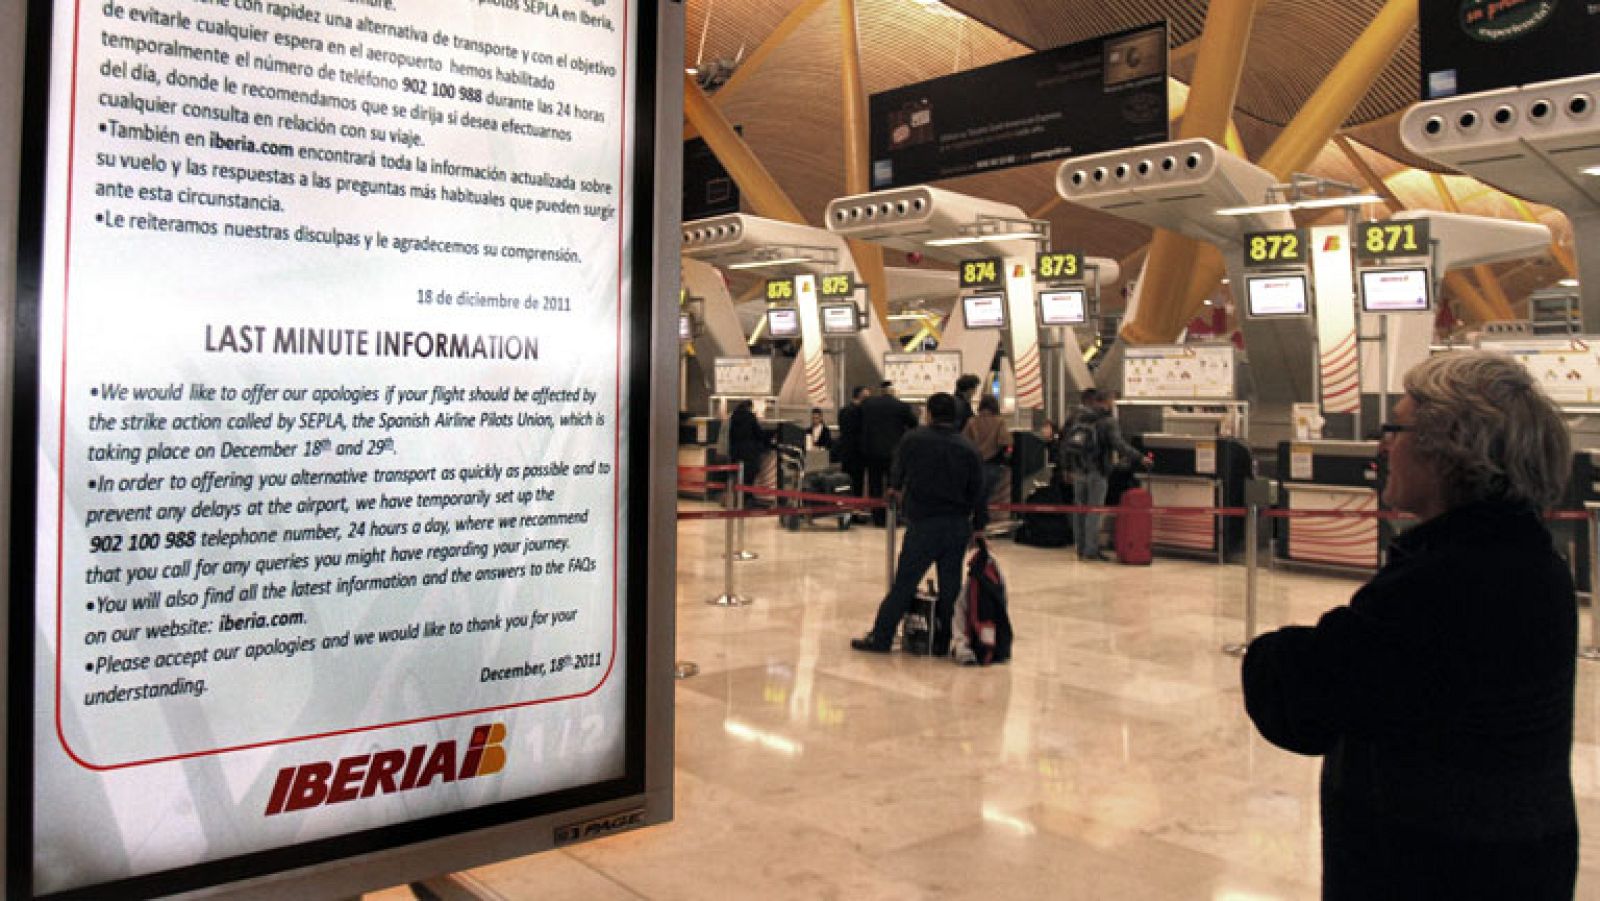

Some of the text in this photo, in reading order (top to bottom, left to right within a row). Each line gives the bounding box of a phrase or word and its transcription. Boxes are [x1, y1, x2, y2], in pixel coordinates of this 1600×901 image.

[101, 30, 229, 65] temporalmente
[234, 50, 250, 67] el
[253, 53, 313, 77] número
[316, 62, 336, 81] de
[338, 68, 398, 90] teléfono
[401, 76, 427, 94] 902
[432, 81, 456, 98] 100
[457, 85, 482, 103] 988
[485, 90, 534, 111] durante
[537, 98, 553, 115] las
[555, 101, 571, 117] 24
[99, 58, 127, 78] del
[165, 68, 219, 92] donde
[224, 75, 237, 94] le
[241, 82, 356, 111] recomendamos
[360, 99, 388, 116] que
[391, 103, 406, 117] se
[409, 103, 444, 126] dirija
[459, 111, 498, 131] desea
[501, 117, 571, 142] efectuarnos
[97, 91, 177, 115] cualquier
[181, 103, 250, 124] consulta
[253, 112, 273, 127] en
[276, 113, 336, 135] relación
[339, 124, 367, 138] con
[370, 128, 386, 142] su
[108, 118, 612, 194] También en iberia.com encontrará toda la información actualizada sobre
[95, 182, 284, 212] ante esta circunstancia.
[105, 209, 124, 227] Le
[128, 211, 217, 236] reiteramos
[224, 222, 290, 240] nuestras
[293, 224, 360, 248] disculpas
[363, 234, 373, 250] y
[376, 230, 388, 248] le
[391, 235, 479, 255] agradecemos
[482, 243, 498, 257] su
[1250, 233, 1299, 261] 872
[1366, 224, 1417, 253] 871
[964, 261, 996, 283] 874
[1040, 254, 1078, 277] 873
[768, 280, 793, 299] 876
[822, 275, 848, 294] 875
[416, 289, 571, 311] 18 de diciembre de 2011
[205, 324, 538, 359] LAST MINUTE INFORMATION
[100, 383, 596, 405] We would like to offer our apologies if your flight should be affected by
[88, 412, 117, 430] the
[120, 412, 167, 430] strike
[171, 412, 221, 430] action
[226, 412, 273, 430] called
[276, 412, 296, 432] by
[351, 412, 375, 428] the
[378, 412, 430, 431] Spanish
[434, 411, 475, 427] Airline
[478, 410, 513, 427] Pilots
[559, 410, 593, 426] which
[87, 442, 142, 465] taking
[145, 441, 190, 463] place
[194, 445, 215, 459] on
[220, 439, 298, 459] December
[335, 439, 364, 455] and
[84, 485, 555, 528] prevent any delays at the airport, we have temporarily set up the
[89, 533, 123, 553] 902
[126, 531, 160, 551] 100
[164, 529, 196, 549] 988
[201, 526, 277, 549] telephone
[282, 522, 342, 542] number,
[347, 520, 365, 538] 24
[368, 519, 408, 536] hours
[411, 521, 421, 534] a
[455, 514, 494, 531] where
[497, 516, 517, 528] we
[518, 508, 589, 527] recommend
[96, 556, 596, 613] You will also find all the latest information and the answers to the FAQs
[84, 630, 106, 645] on
[110, 627, 141, 642] our
[145, 618, 213, 639] website:
[571, 652, 600, 670] 2011
[264, 739, 457, 816] IBERIA
